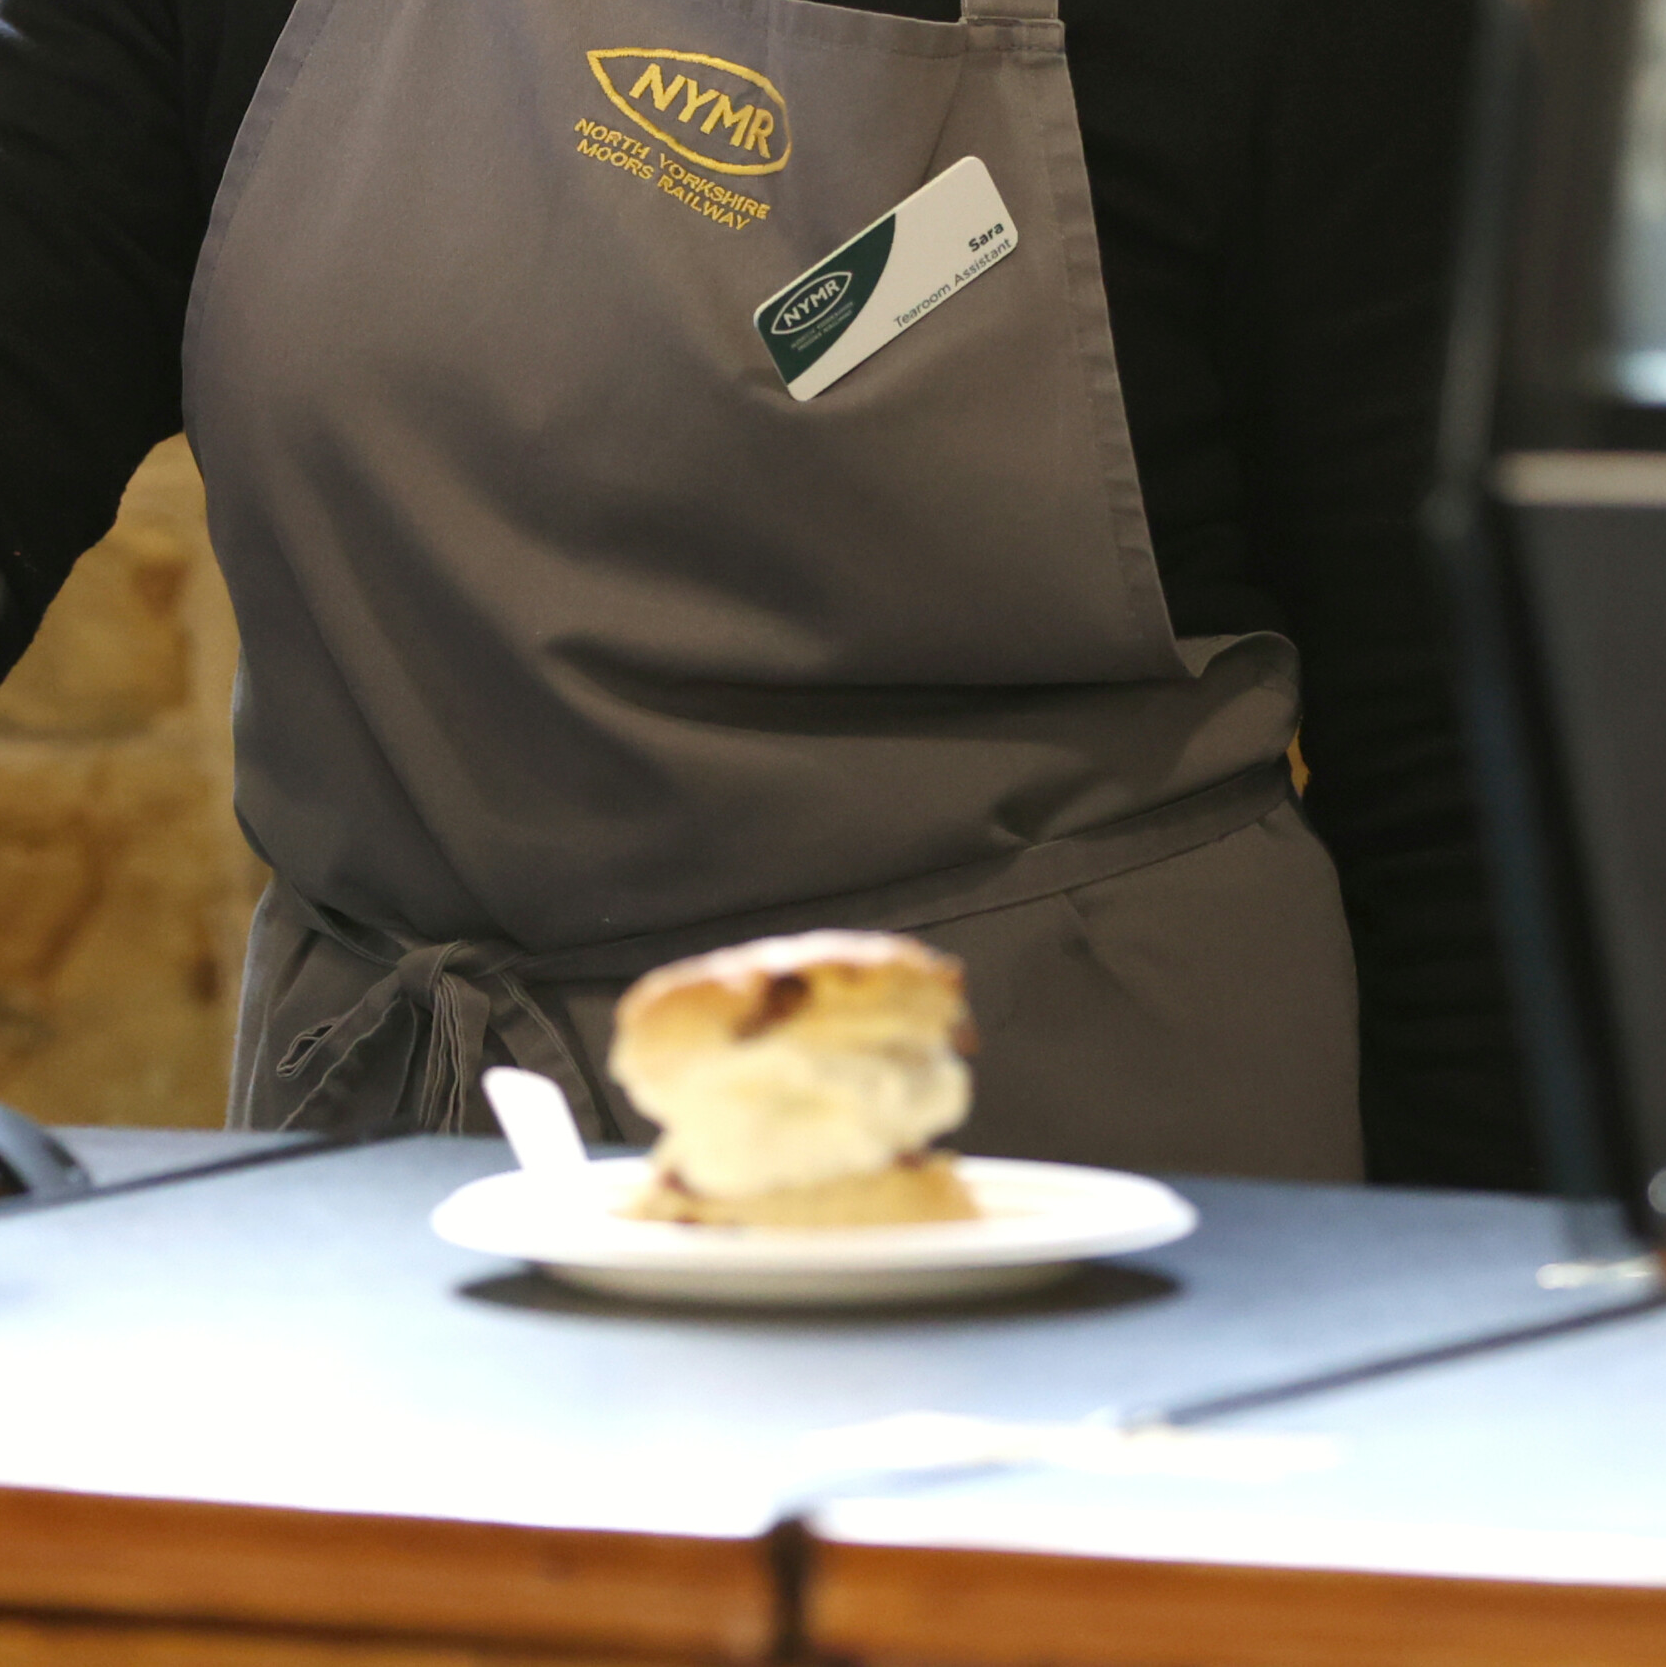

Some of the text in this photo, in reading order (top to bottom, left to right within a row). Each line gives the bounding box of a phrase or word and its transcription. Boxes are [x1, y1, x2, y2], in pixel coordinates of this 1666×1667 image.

[629, 63, 774, 159] NYMR
[574, 118, 771, 220] NORTH YORKSHIRE
[577, 139, 751, 231] MOORS RAILWAY
[968, 223, 1005, 252] Sara
[783, 279, 841, 327] NYMR
[894, 283, 952, 328] Tearoom
[954, 239, 1012, 287] Assistant
